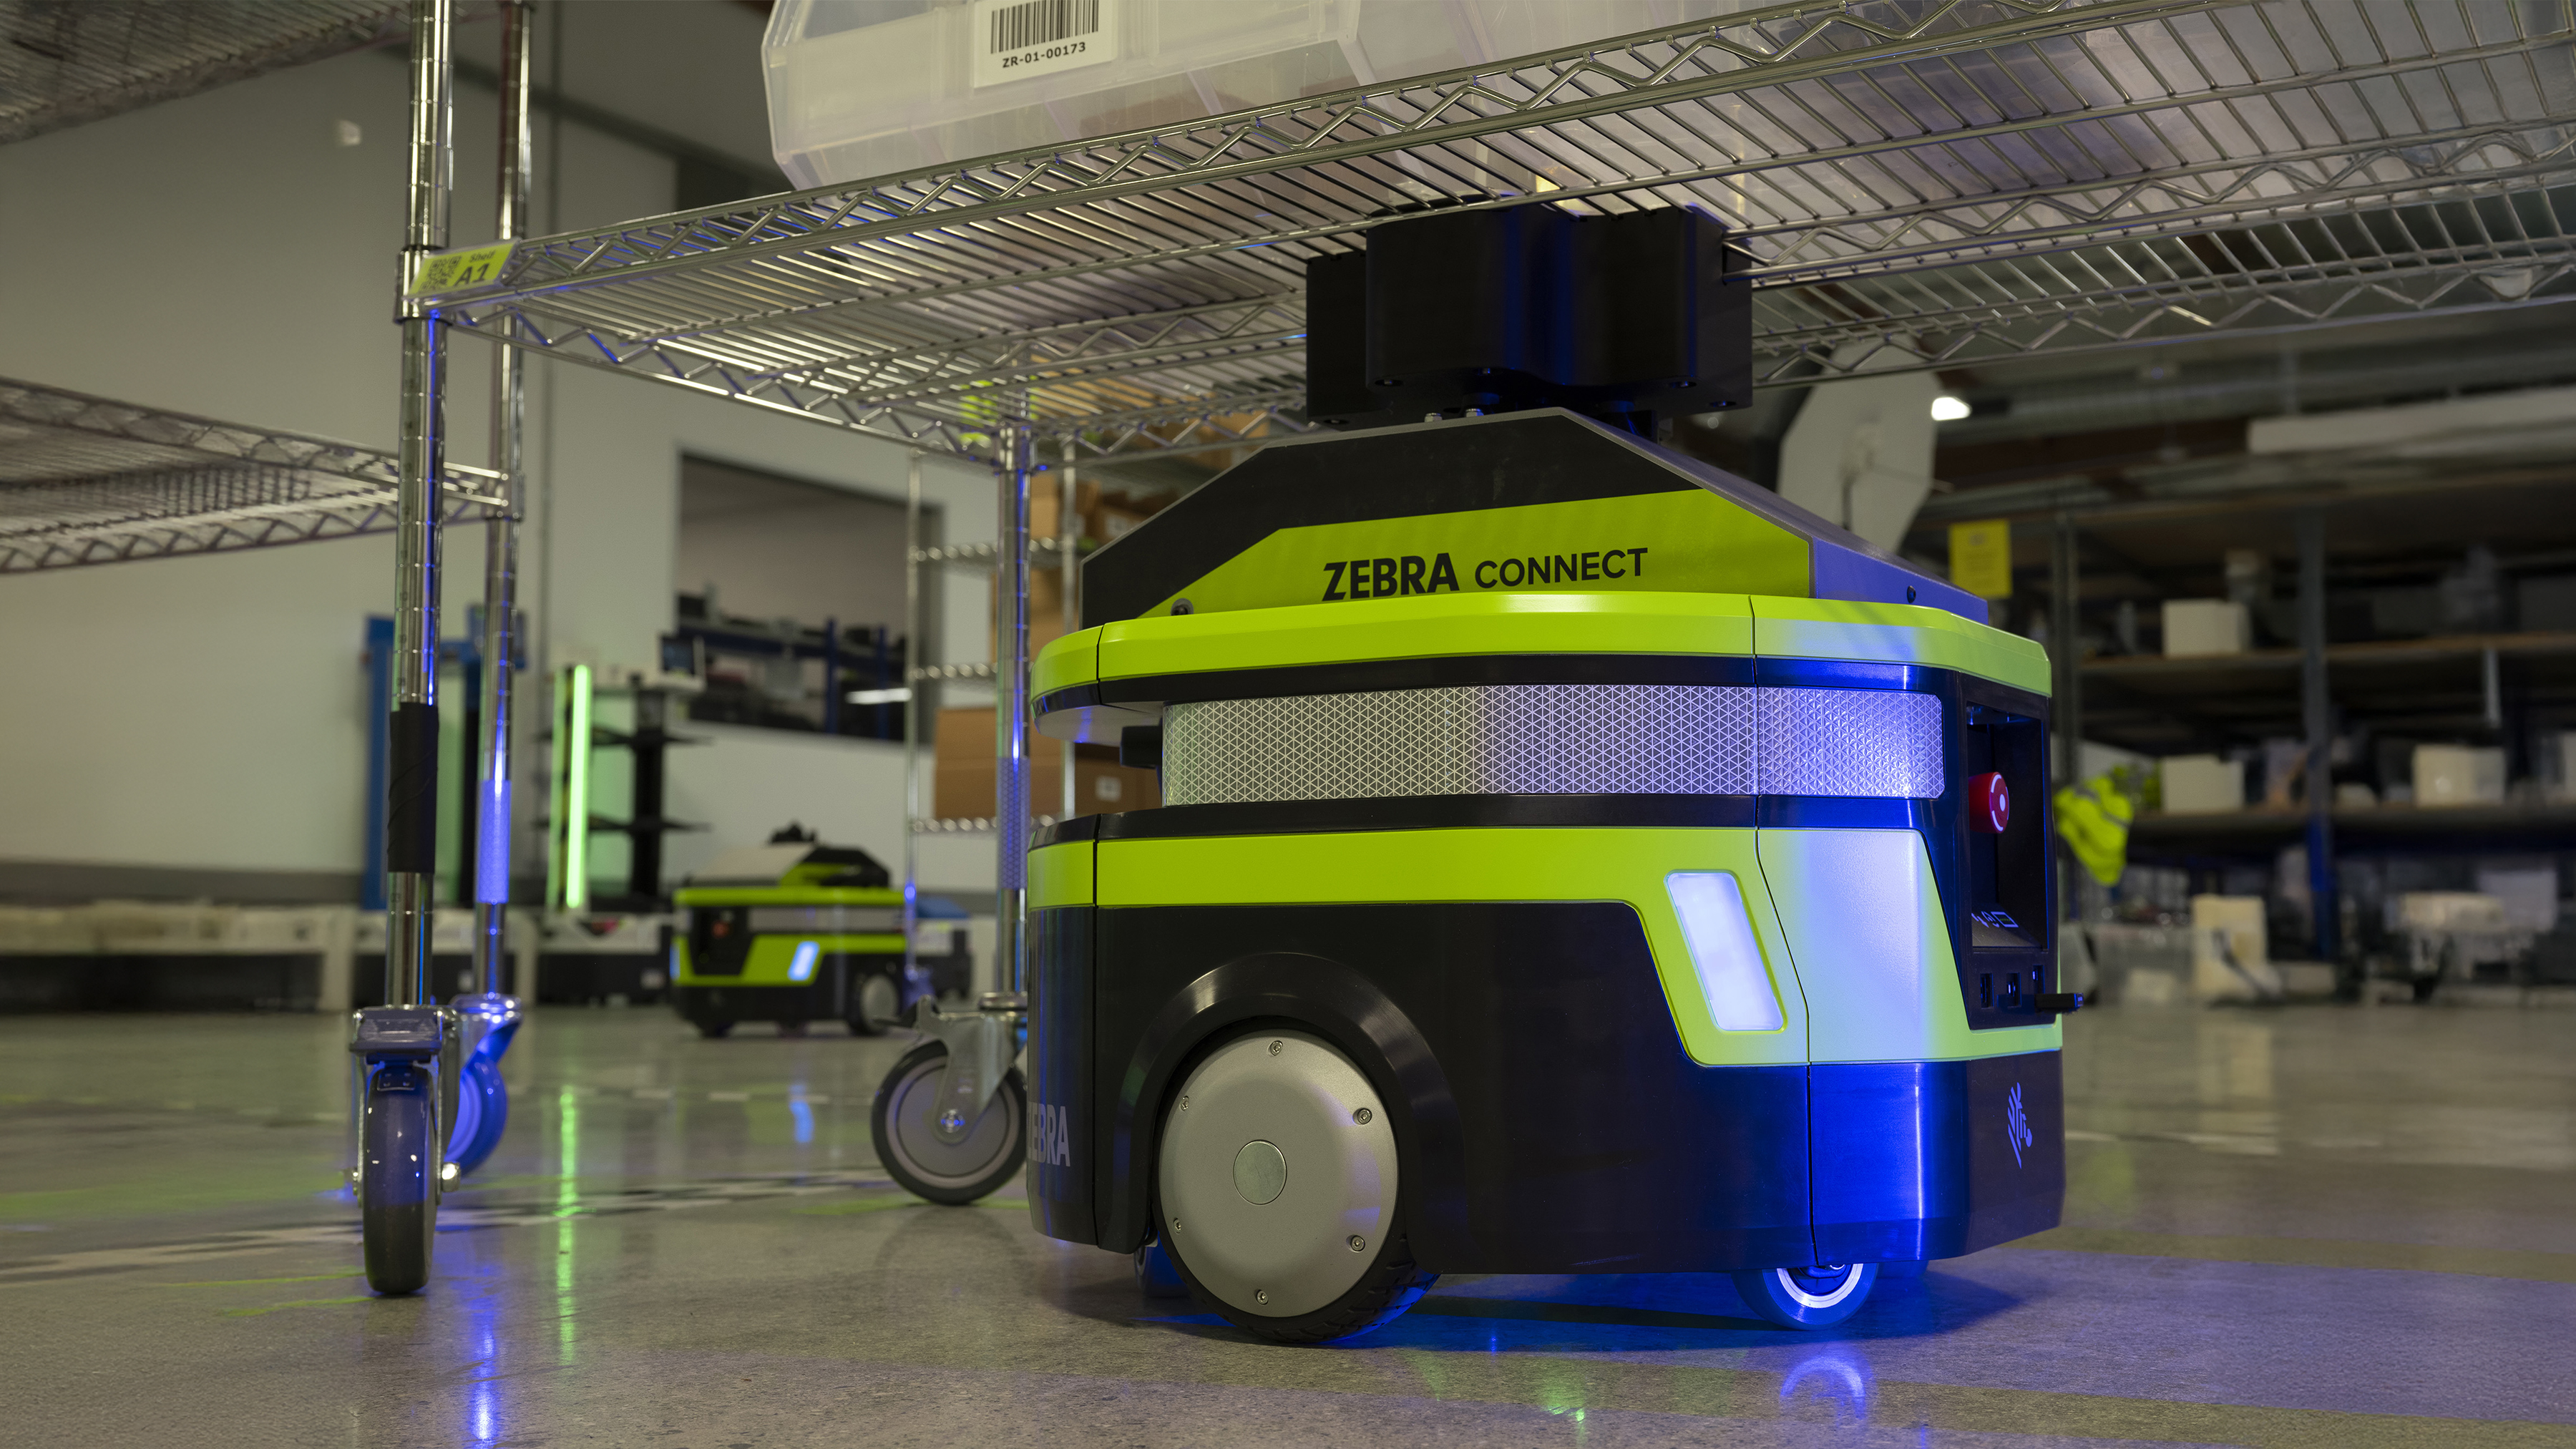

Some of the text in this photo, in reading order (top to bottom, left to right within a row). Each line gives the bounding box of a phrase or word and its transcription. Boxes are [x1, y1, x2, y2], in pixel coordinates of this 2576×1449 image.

[1002, 42, 1085, 68] ZR-01-00173
[469, 249, 497, 263] Shelf
[454, 263, 490, 286] A1
[1322, 547, 1648, 602] ZEBRA CONNECT
